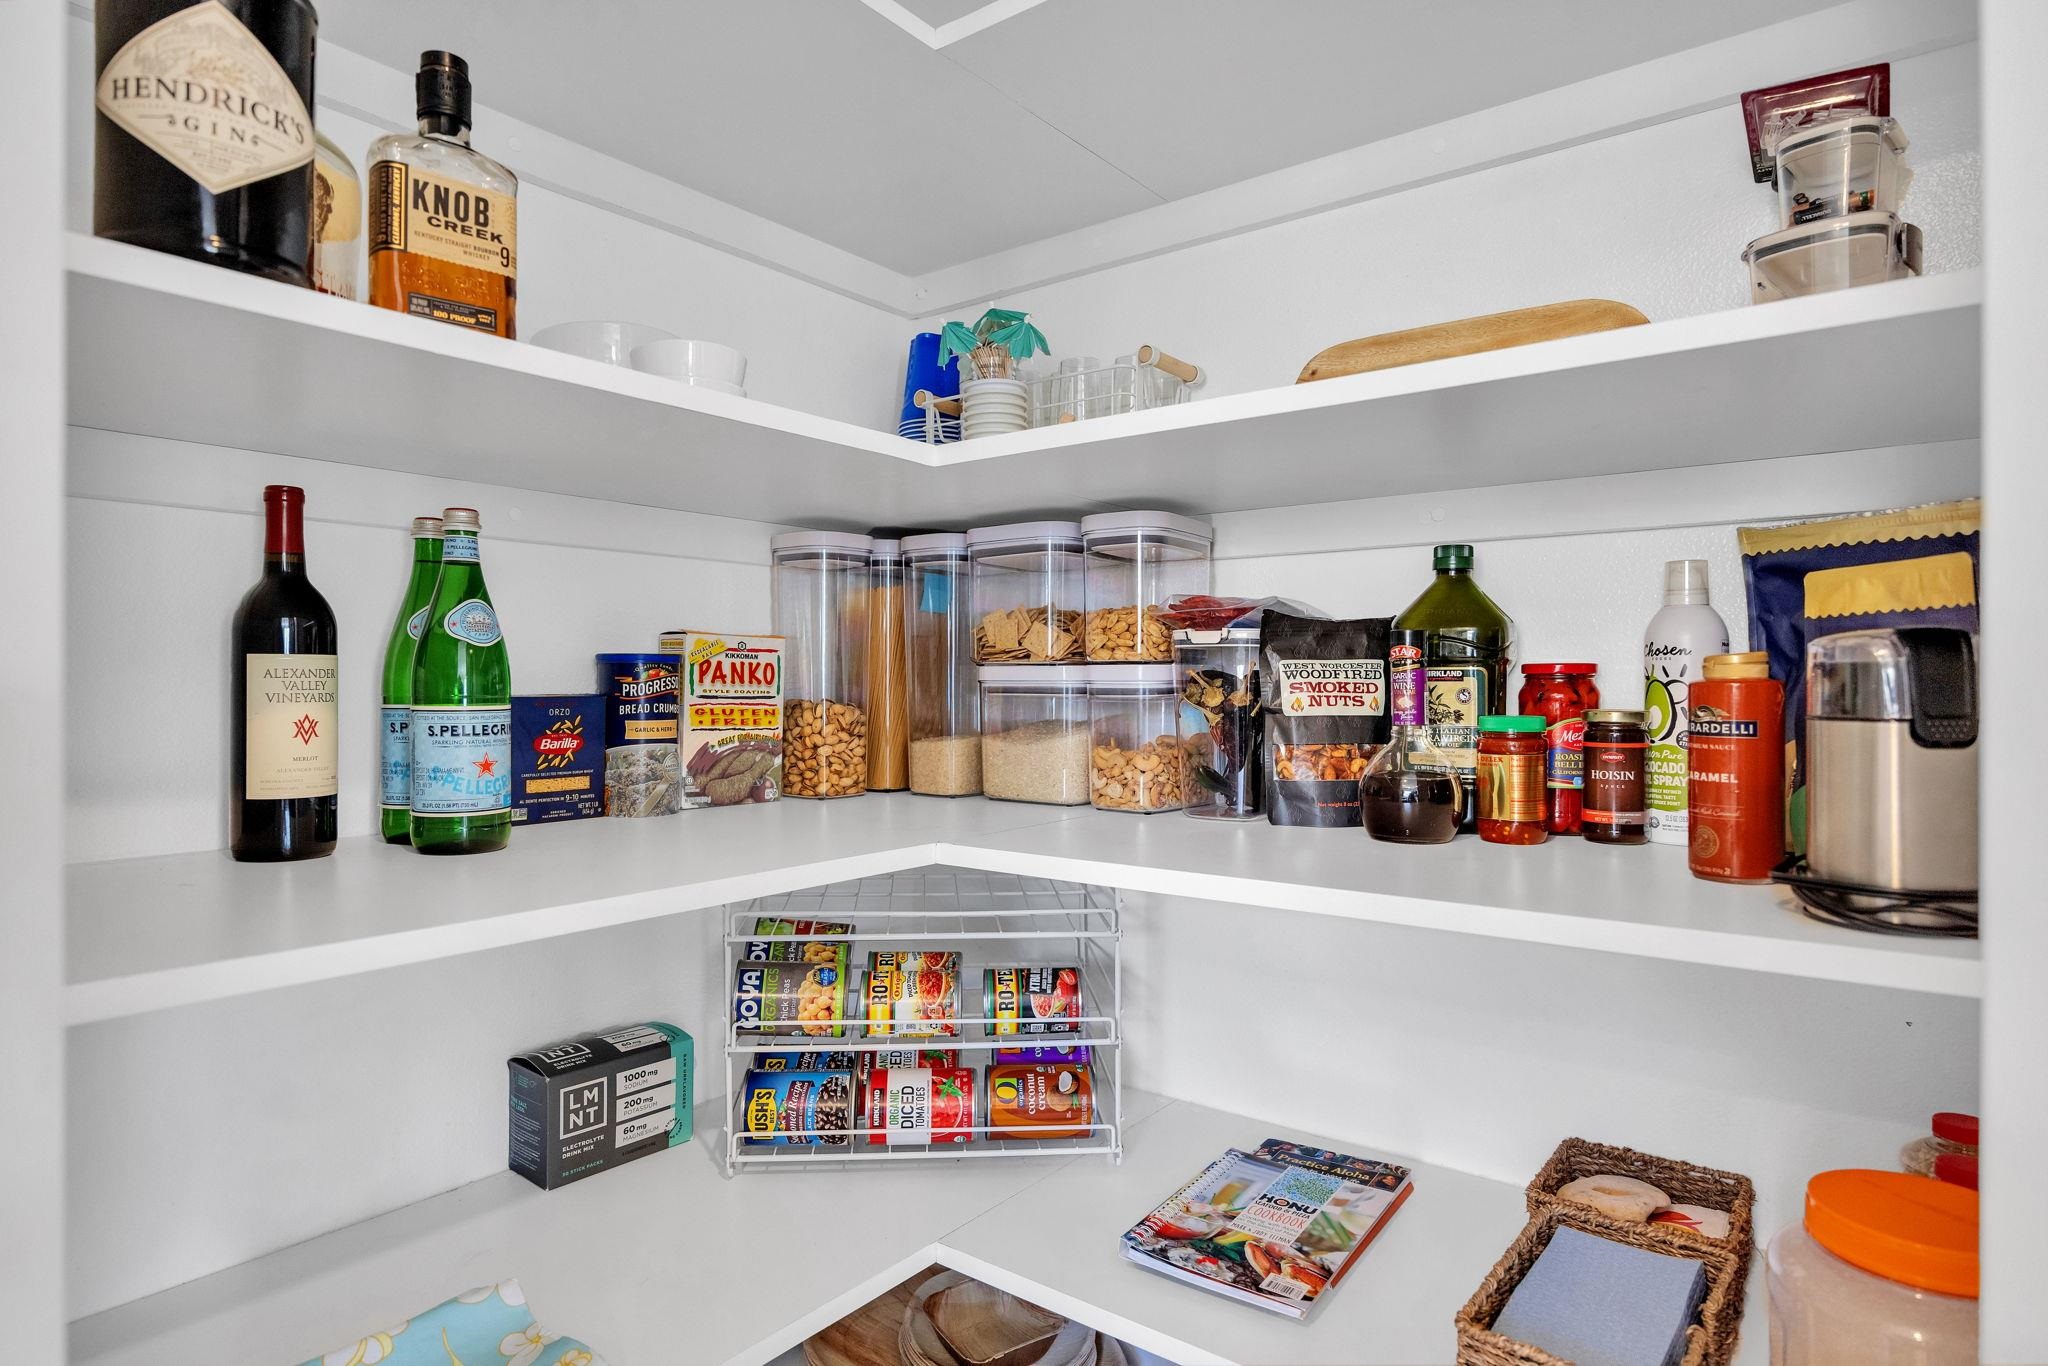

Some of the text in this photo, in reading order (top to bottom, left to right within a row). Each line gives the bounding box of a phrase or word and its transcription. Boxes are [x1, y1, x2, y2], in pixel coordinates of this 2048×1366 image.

[112, 77, 305, 145] HENDRICK'S
[184, 116, 247, 144] GIN
[392, 168, 400, 205] KENTUCKY
[412, 178, 490, 228] KNOB
[427, 215, 503, 245] CREEK
[463, 250, 490, 261] WHISKEY
[473, 245, 499, 256] BOURBON
[500, 247, 510, 268] 9
[433, 309, 449, 319] 100
[450, 313, 476, 324] PROOF
[690, 640, 719, 657] RESEALABLE
[701, 651, 712, 660] BAG
[725, 652, 759, 660] KIKKOMAN
[1390, 647, 1417, 658] STAR
[263, 668, 336, 679] ALEXANDER
[699, 660, 776, 687] PANKO
[1282, 662, 1382, 670] WEST WORCESTER
[1283, 669, 1383, 681] WOODFIRED
[282, 680, 328, 691] VALLEY
[1289, 681, 1379, 694] SMOKED
[1394, 682, 1416, 690] WINE
[265, 692, 335, 703] VINEYARDS
[1308, 695, 1365, 707] NUTS
[548, 708, 570, 716] ORZO
[619, 703, 650, 715] BREAD
[694, 707, 776, 717] GLUTEN
[710, 717, 762, 726] FREE
[540, 738, 577, 750] Barilla
[717, 734, 735, 747] GREAT
[1441, 734, 1477, 743] VIRGIN
[1662, 749, 1684, 760] Pure
[1709, 743, 1736, 751] SAUCE
[1591, 769, 1635, 781] HOISIN
[1653, 774, 1688, 786] SPRAY
[1328, 801, 1343, 809] weight
[783, 978, 791, 999] Peas
[740, 971, 761, 1029] GOYA
[764, 969, 779, 1031] ORGANICS
[998, 990, 1014, 1011] RO
[547, 1044, 576, 1058] NT
[553, 1053, 593, 1067] ELECTROLYTE
[556, 1058, 586, 1070] DRINK MIX
[623, 1068, 658, 1083] 1000 mg
[623, 1078, 648, 1091] SODIUM
[569, 1086, 599, 1110] LM
[788, 1081, 803, 1110] Recipe
[1017, 1079, 1025, 1107] organics
[1027, 1072, 1036, 1115] coconut
[1038, 1076, 1046, 1111] cream
[623, 1095, 654, 1110] 200 mg
[623, 1101, 658, 1116] POTASSIUM
[807, 1094, 815, 1116] BEANS
[889, 1089, 900, 1125] ORGANIC
[901, 1086, 914, 1129] DICED
[915, 1087, 926, 1128] TOMATOES
[569, 1105, 599, 1130] NT
[755, 1090, 773, 1139] USH'S
[622, 1125, 659, 1142] MAGNESIUM
[623, 1122, 647, 1135] 60 mg
[562, 1134, 605, 1152] ELECTROLYTE
[562, 1144, 595, 1159] DRINK MIX
[570, 1165, 585, 1175] STICK
[586, 1159, 604, 1170] PACKS
[1277, 1153, 1329, 1172] Practice
[1331, 1167, 1370, 1181] Aloha
[1255, 1200, 1282, 1212] SEAFOOD
[1290, 1209, 1311, 1220] PIZZA
[1257, 1193, 1319, 1214] HONU
[1246, 1206, 1308, 1230] COOKBOOK
[1231, 1222, 1247, 1232] MARK
[1253, 1229, 1268, 1239] JUDY
